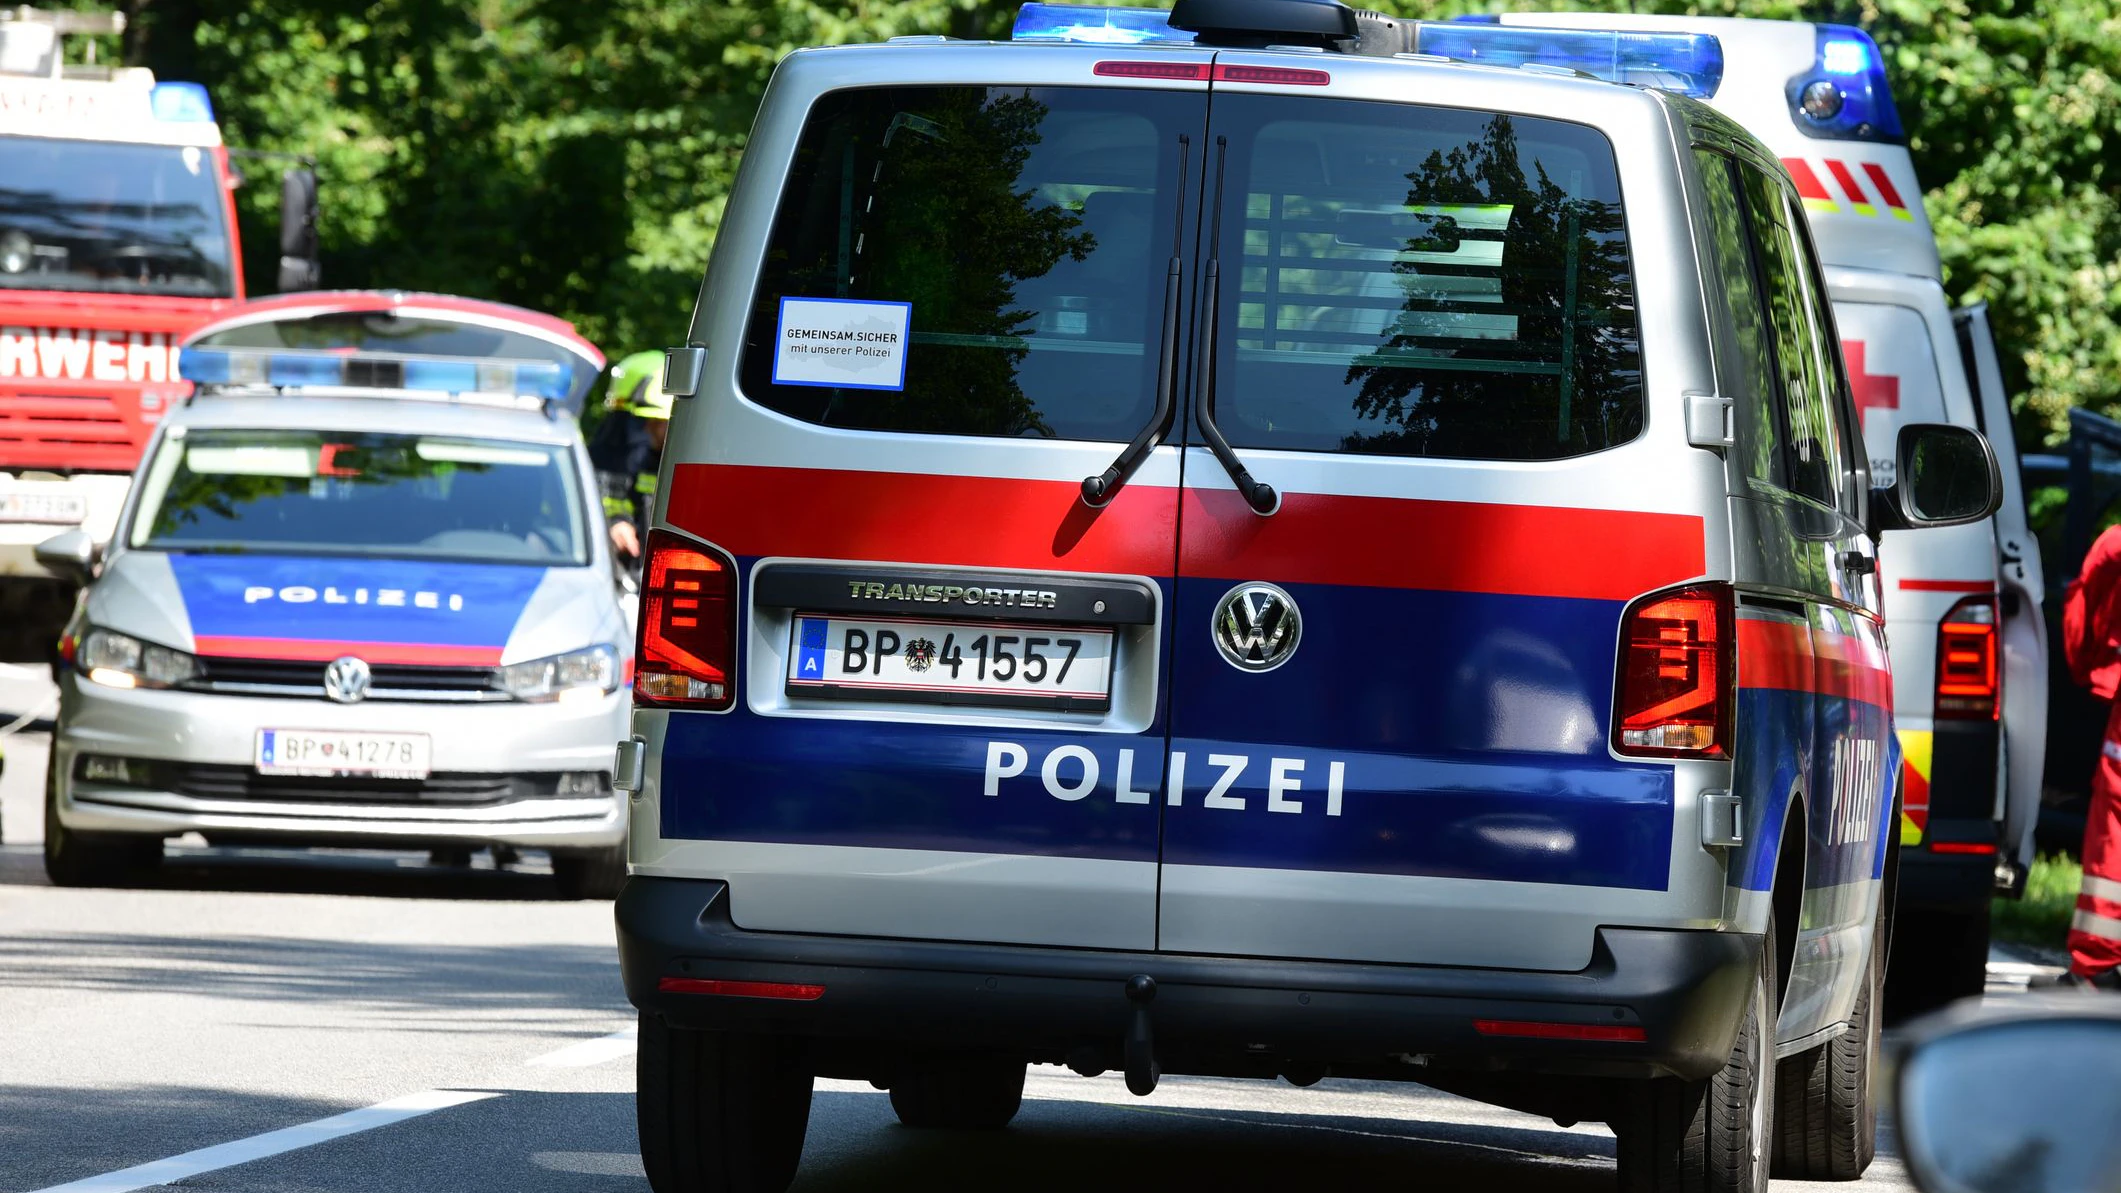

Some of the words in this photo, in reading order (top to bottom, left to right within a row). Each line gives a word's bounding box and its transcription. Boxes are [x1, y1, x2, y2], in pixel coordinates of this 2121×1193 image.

[787, 328, 898, 343] GEMEINSAM.SICHER
[791, 344, 808, 354] mit
[811, 346, 853, 356] unserer
[855, 346, 891, 358] Polizei
[244, 585, 464, 612] POLIZEI
[848, 580, 1057, 609] TRANSPORTER
[804, 656, 818, 672] A
[843, 628, 901, 675] BP
[939, 633, 1082, 685] 41557
[286, 737, 316, 761] BP
[339, 739, 413, 764] 41278
[983, 741, 1346, 817] POLIZEI
[1827, 737, 1876, 846] POLIZEI
